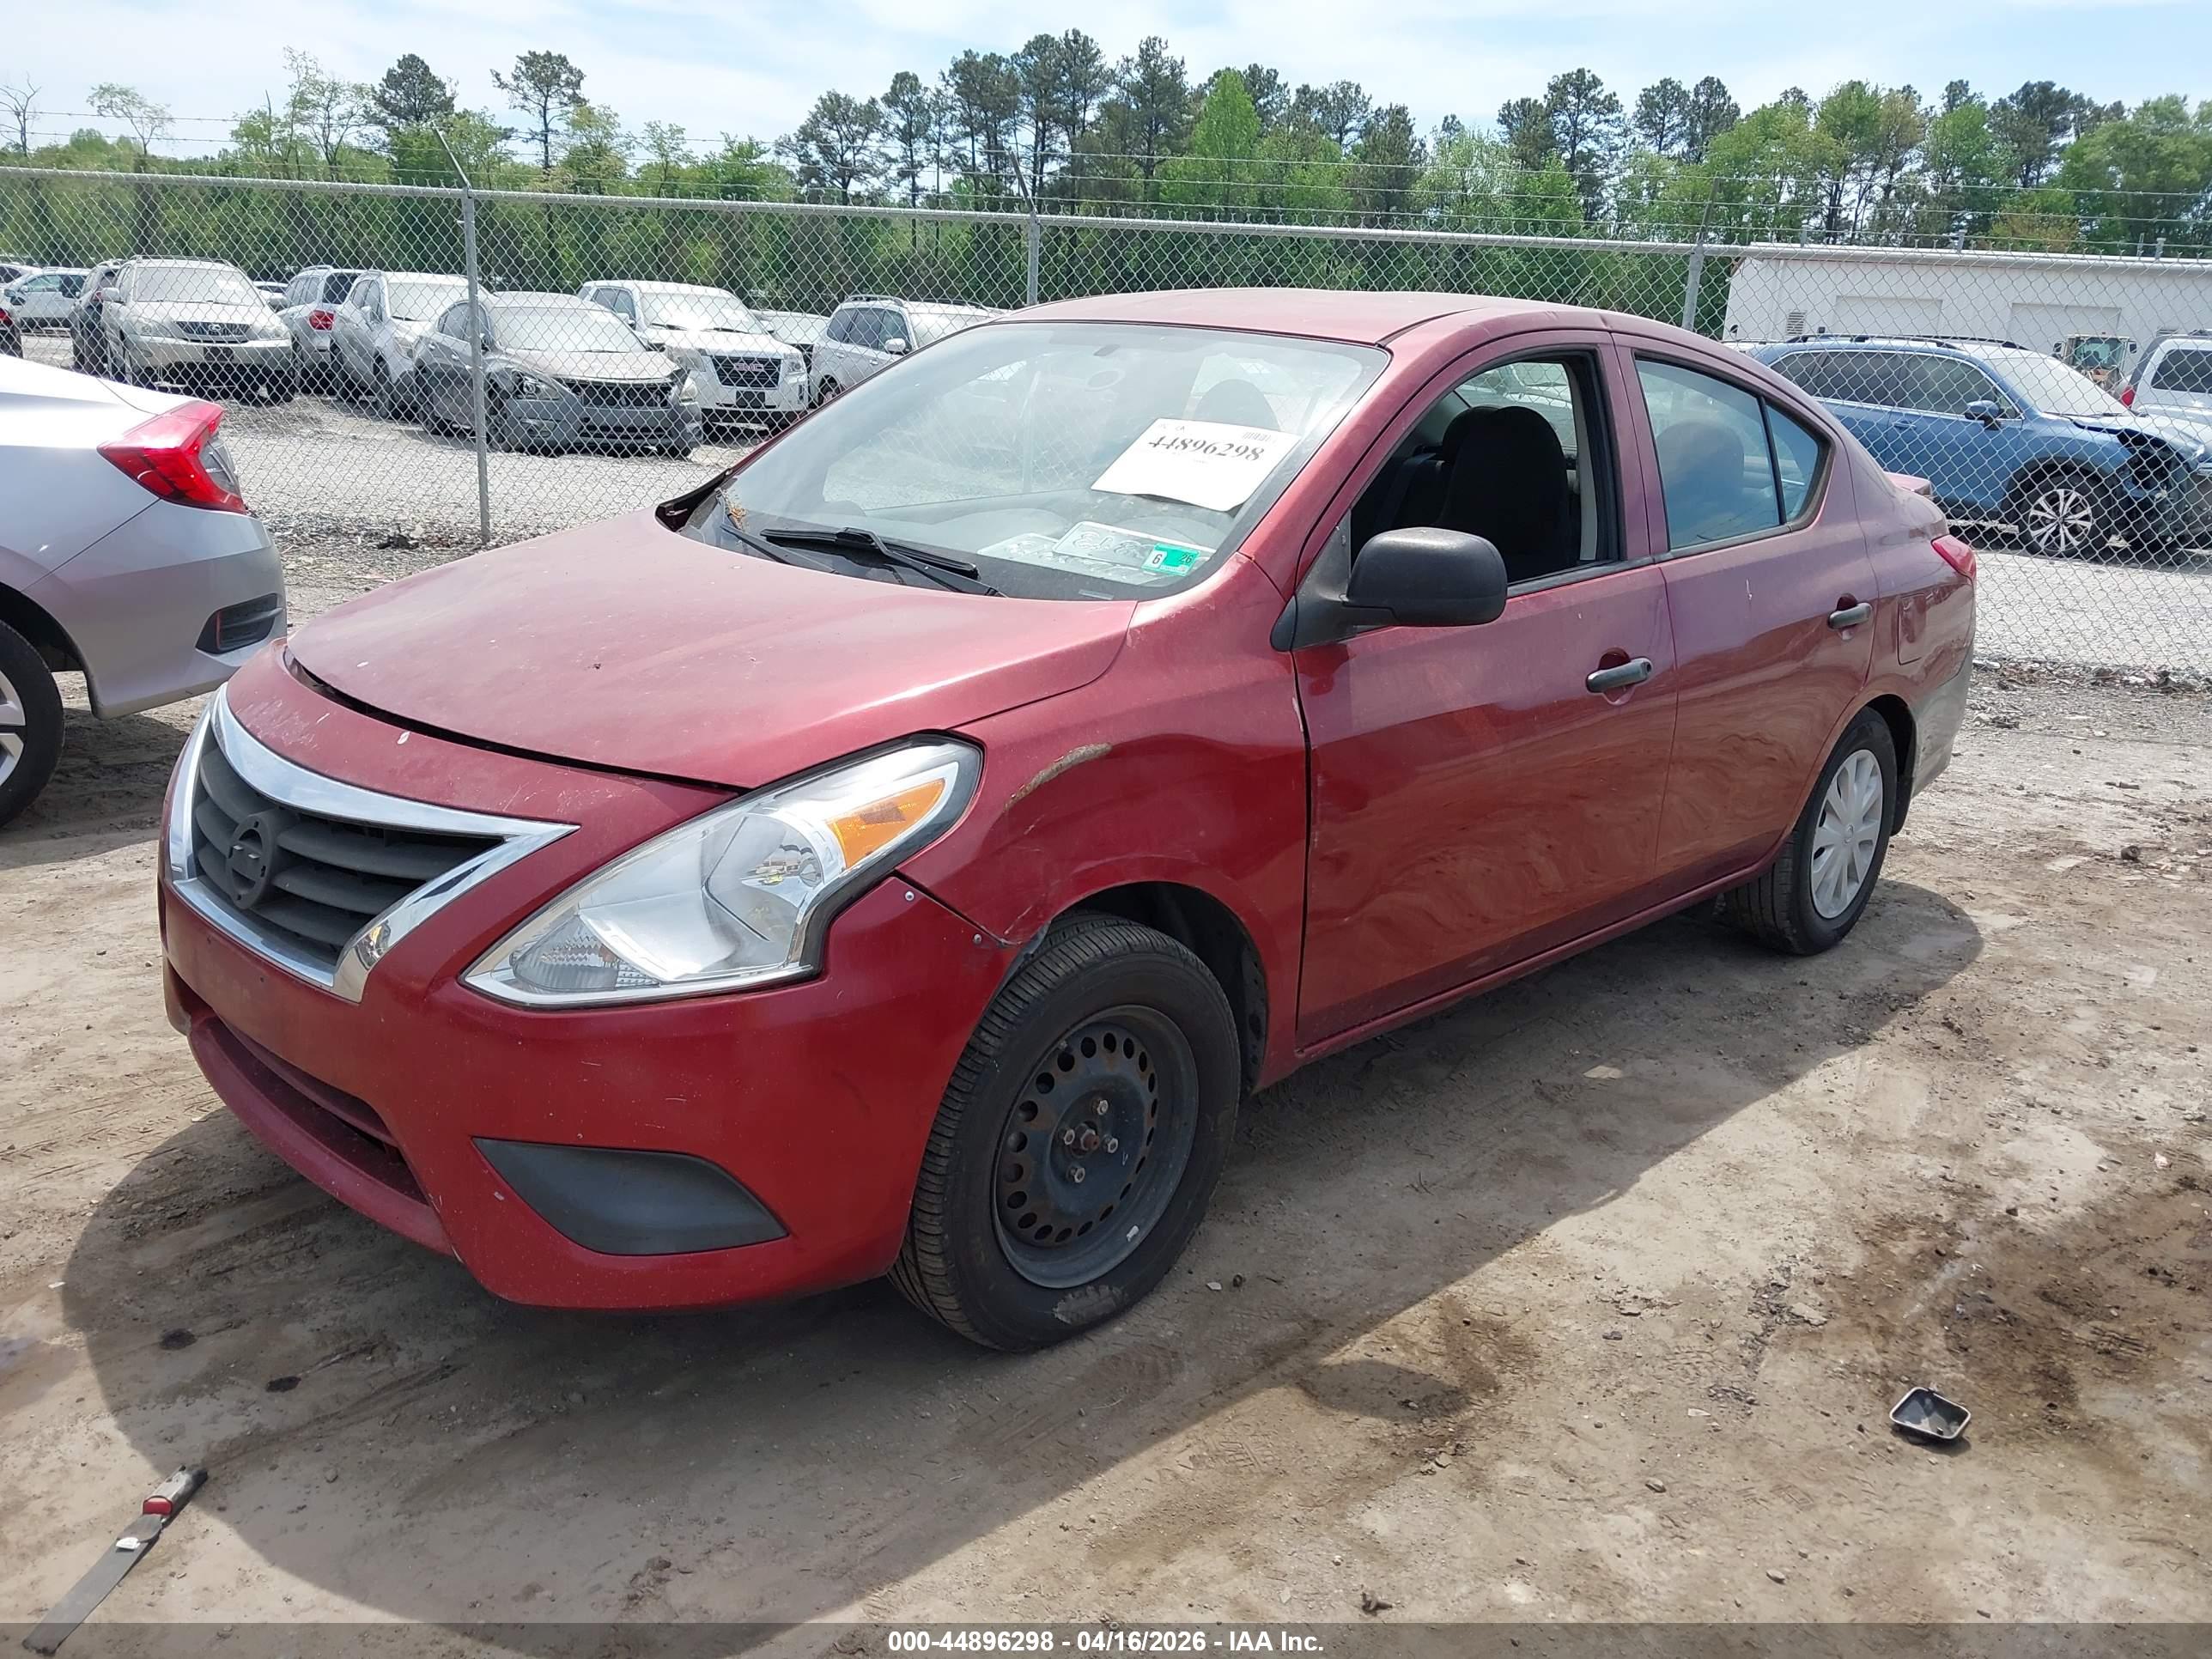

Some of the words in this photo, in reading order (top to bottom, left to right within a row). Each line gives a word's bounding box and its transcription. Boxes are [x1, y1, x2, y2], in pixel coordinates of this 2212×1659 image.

[1148, 435, 1265, 461] 44896298
[1152, 554, 1163, 564] 6
[1179, 552, 1194, 564] 26
